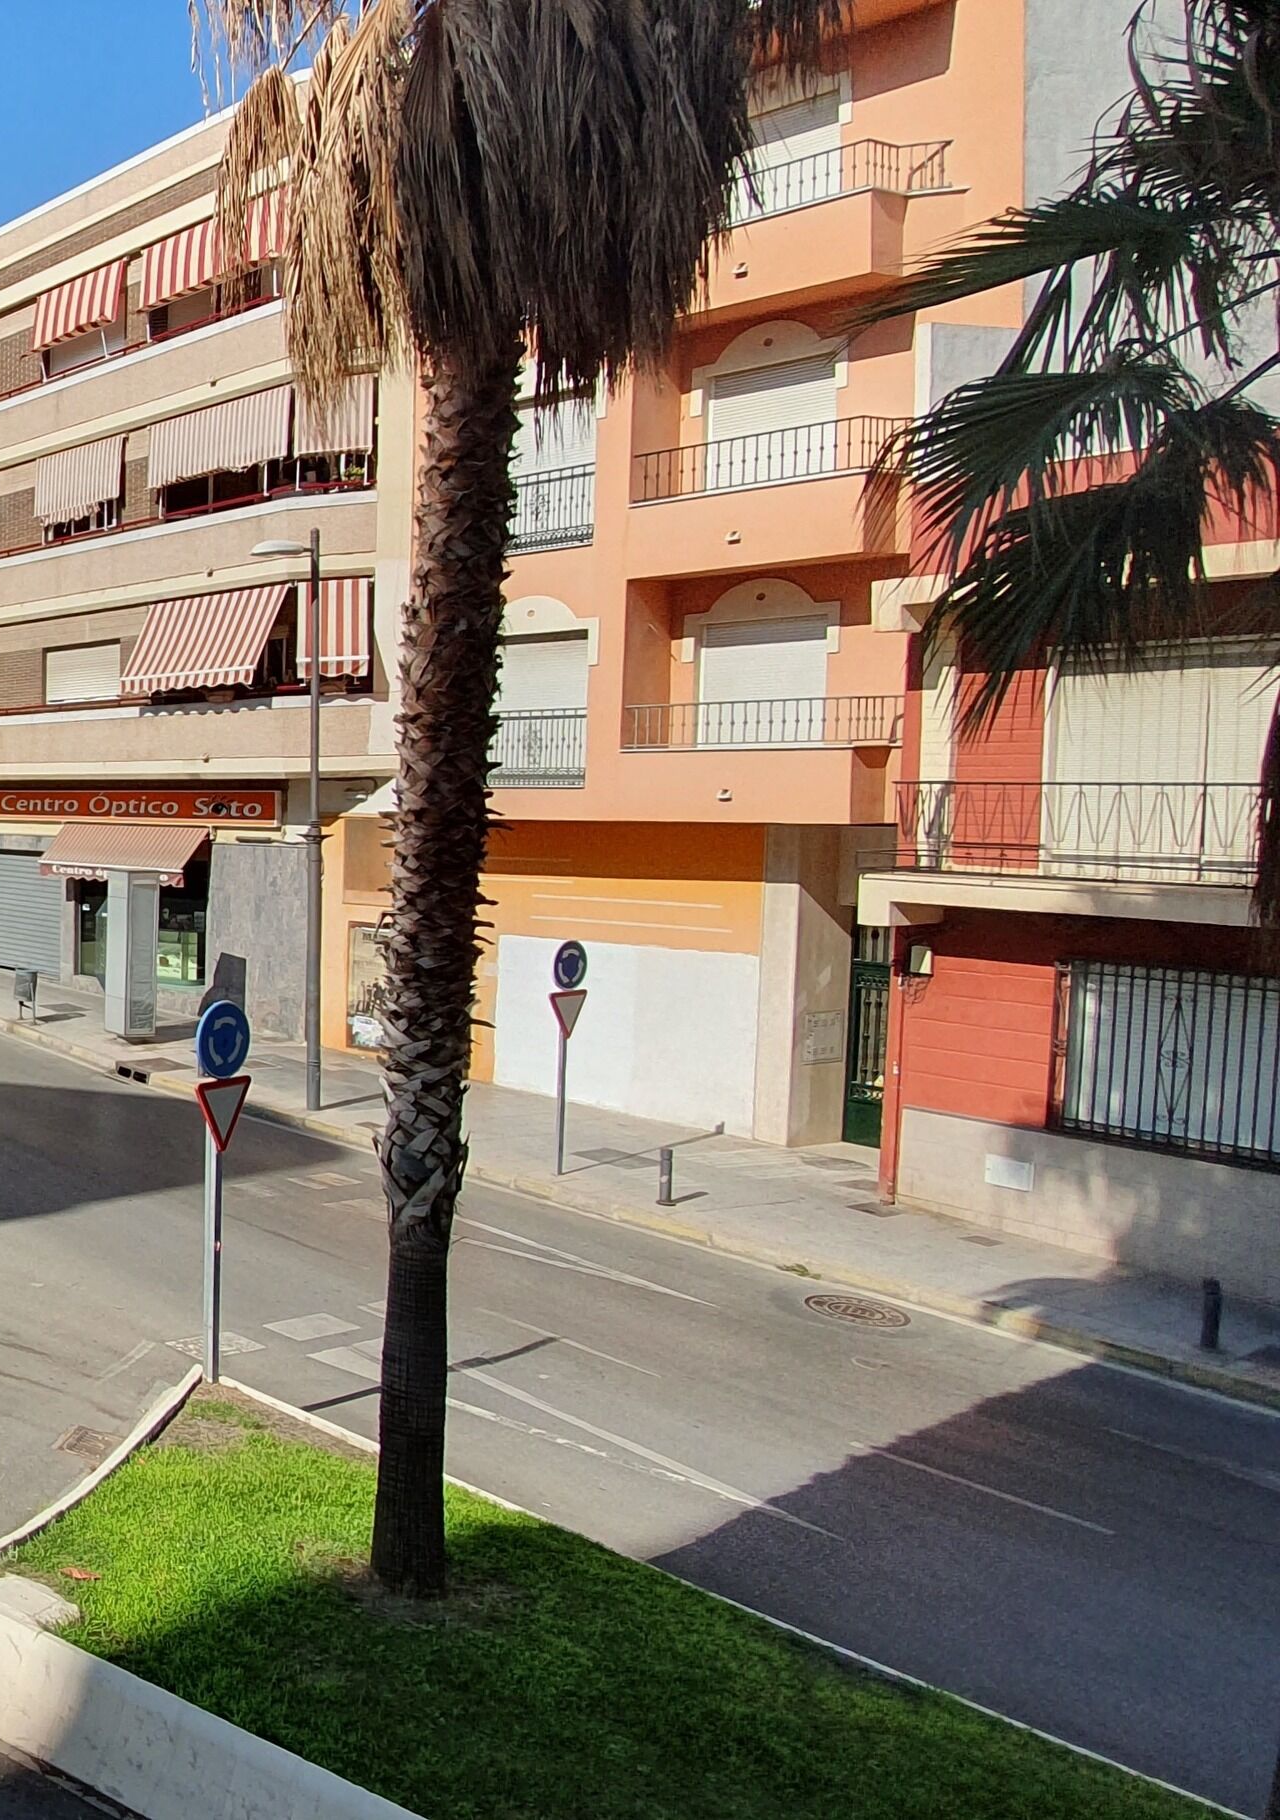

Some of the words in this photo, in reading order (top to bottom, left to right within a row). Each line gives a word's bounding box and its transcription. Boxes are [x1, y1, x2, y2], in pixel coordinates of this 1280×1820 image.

[0, 795, 79, 812] Centro
[89, 792, 179, 817] Óptico
[192, 797, 263, 818] Soto
[52, 865, 93, 876] Centro
